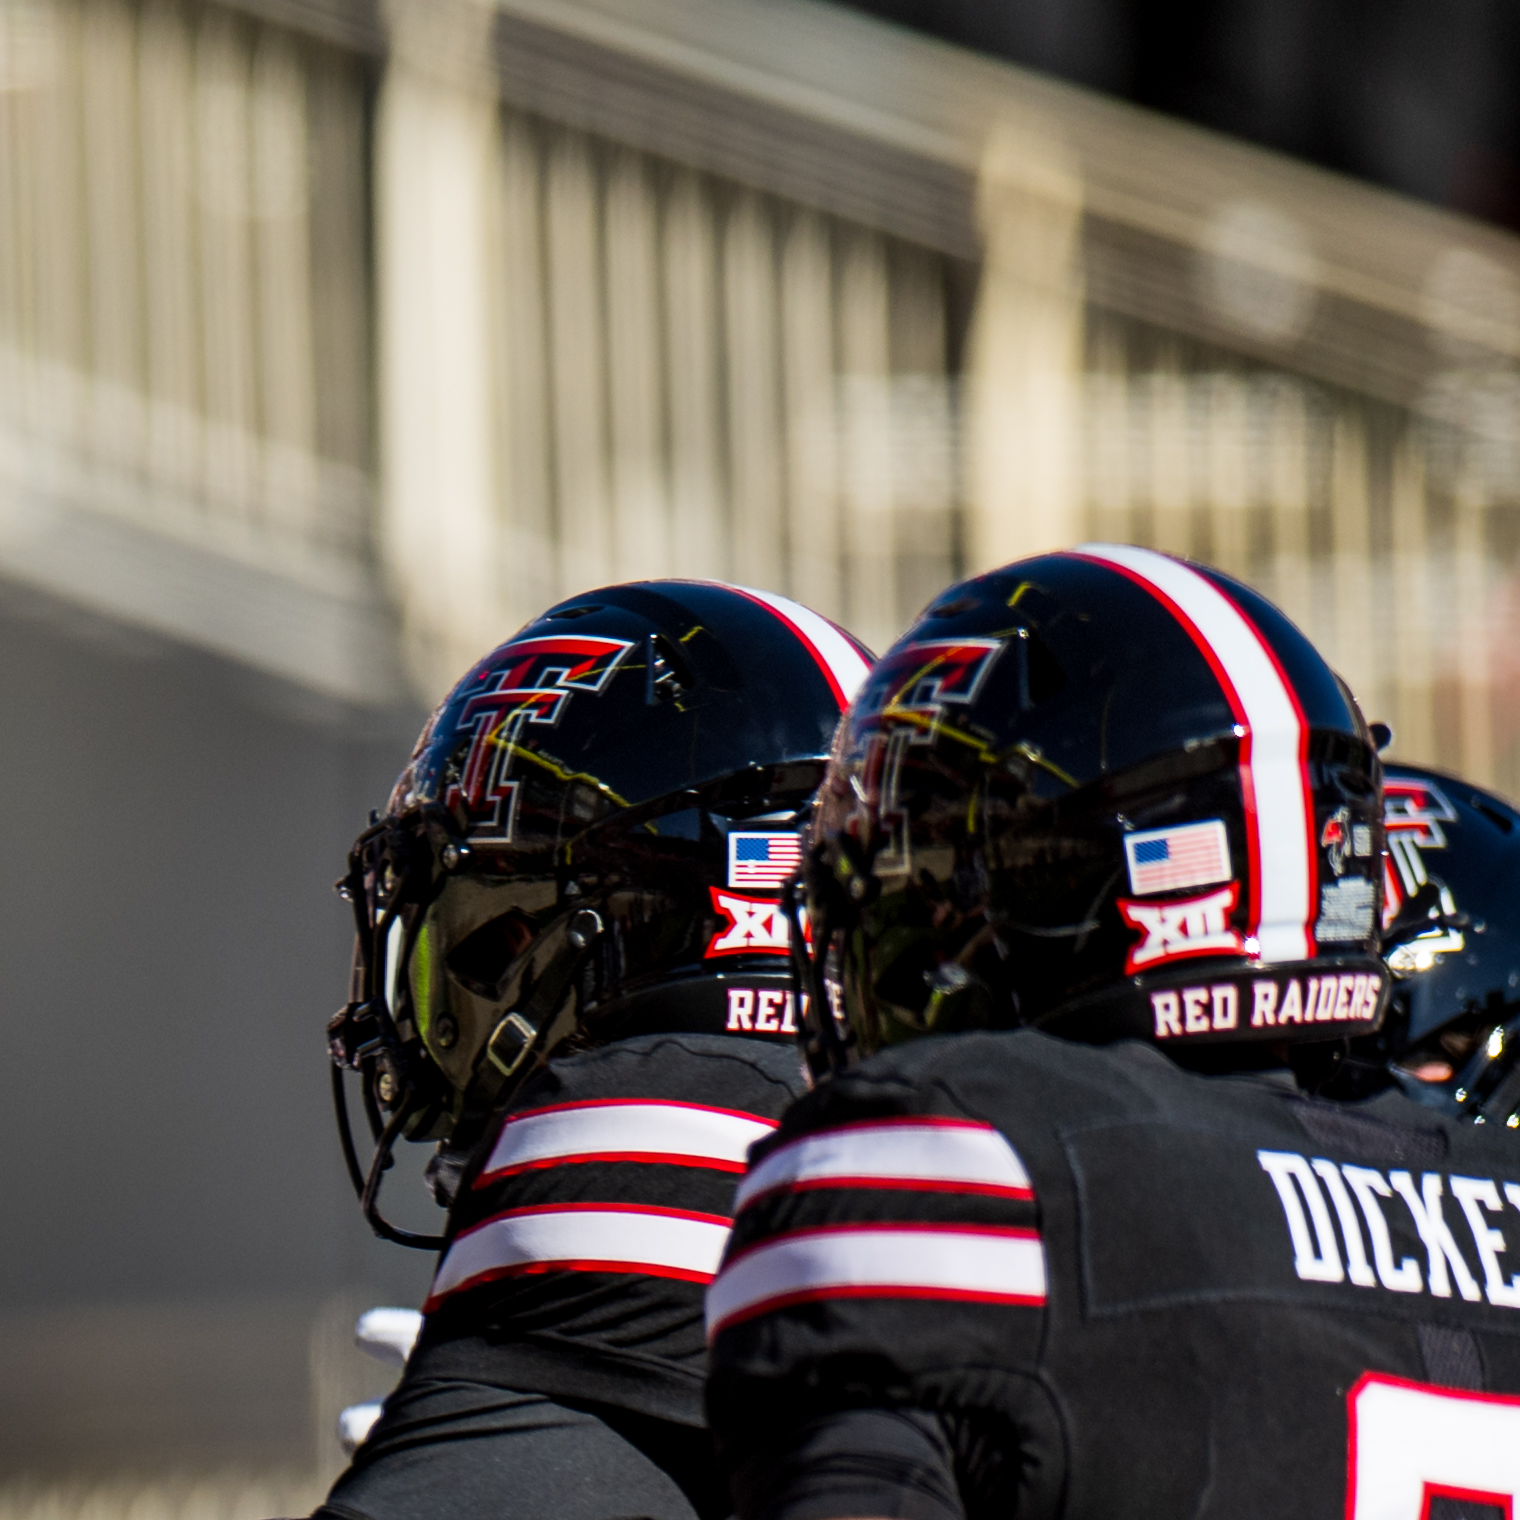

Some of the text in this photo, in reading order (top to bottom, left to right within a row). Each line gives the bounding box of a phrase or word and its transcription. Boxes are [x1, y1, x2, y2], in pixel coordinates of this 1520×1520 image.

[1150, 972, 1384, 1038] RED RAIDERS
[1257, 1149, 1520, 1309] DICKE
